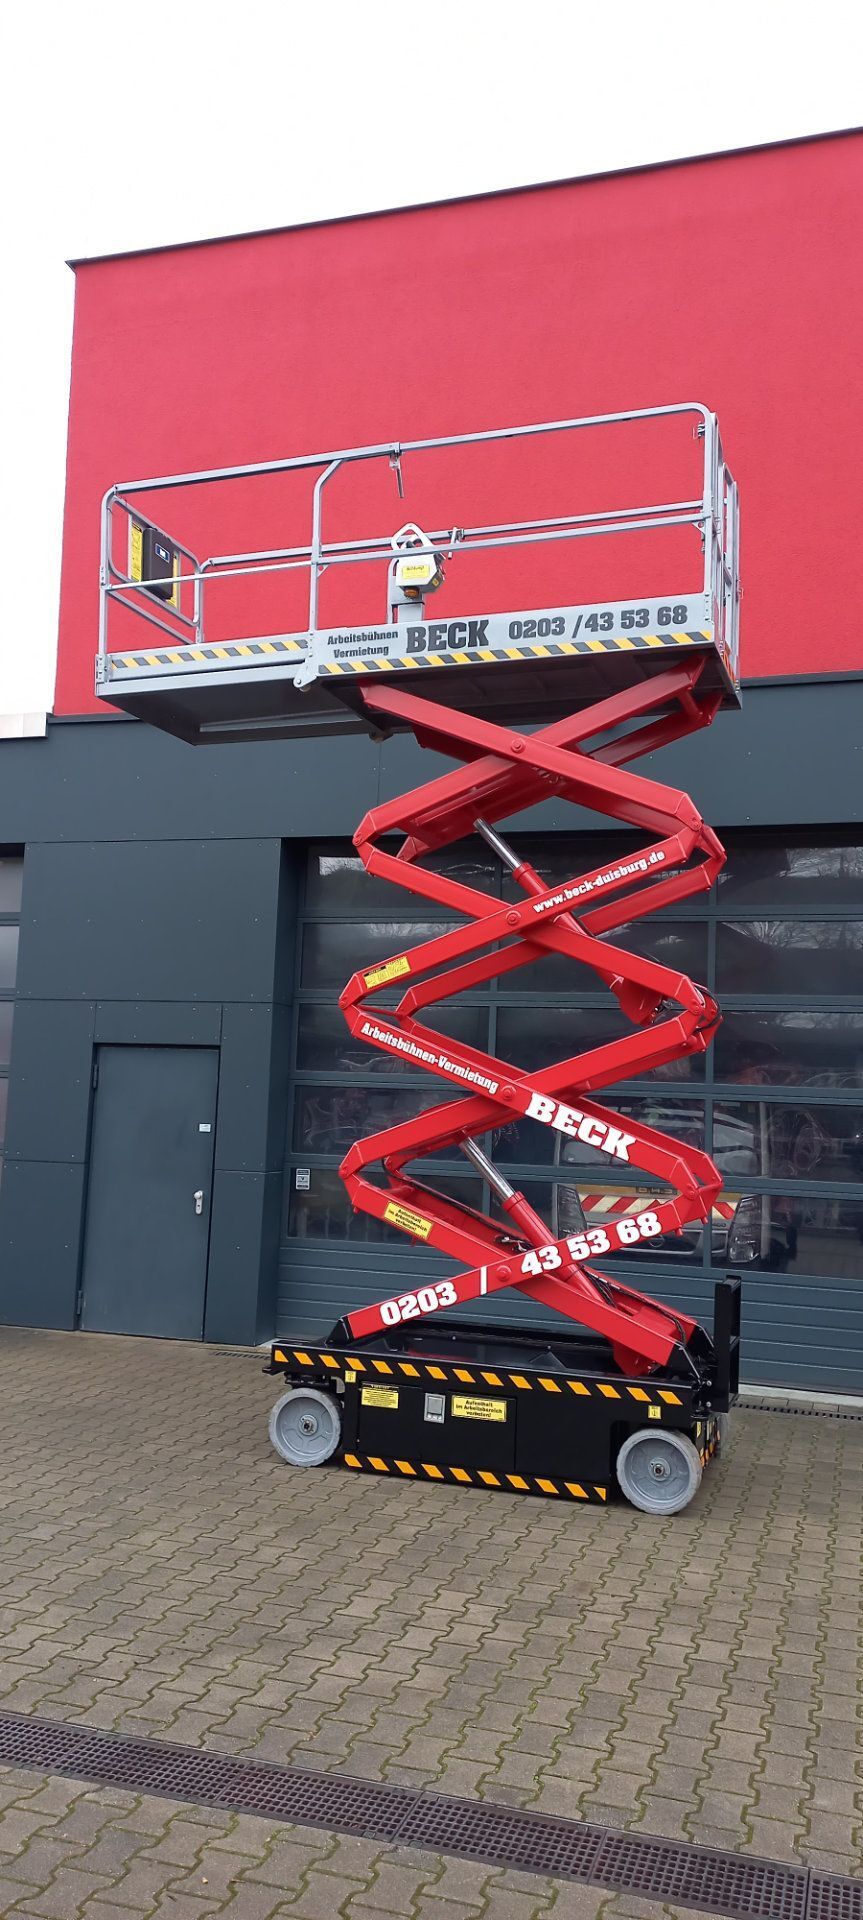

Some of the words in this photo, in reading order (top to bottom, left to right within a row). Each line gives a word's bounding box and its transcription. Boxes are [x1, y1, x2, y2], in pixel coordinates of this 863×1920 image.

[327, 630, 399, 646] Arbeitsbühnen
[406, 620, 489, 653] BECK
[508, 615, 566, 640] 0203
[620, 608, 650, 629] 53
[657, 604, 688, 626] 68
[333, 644, 390, 659] Vermietung
[533, 850, 666, 913] www.beck-duisburg.de
[361, 1022, 499, 1094] Arbeitsbühnen-Vermietung
[525, 1092, 637, 1163] BECK
[379, 1281, 458, 1326] 0203
[520, 1245, 563, 1276] 43
[567, 1229, 611, 1261] 53
[616, 1212, 663, 1244] 68
